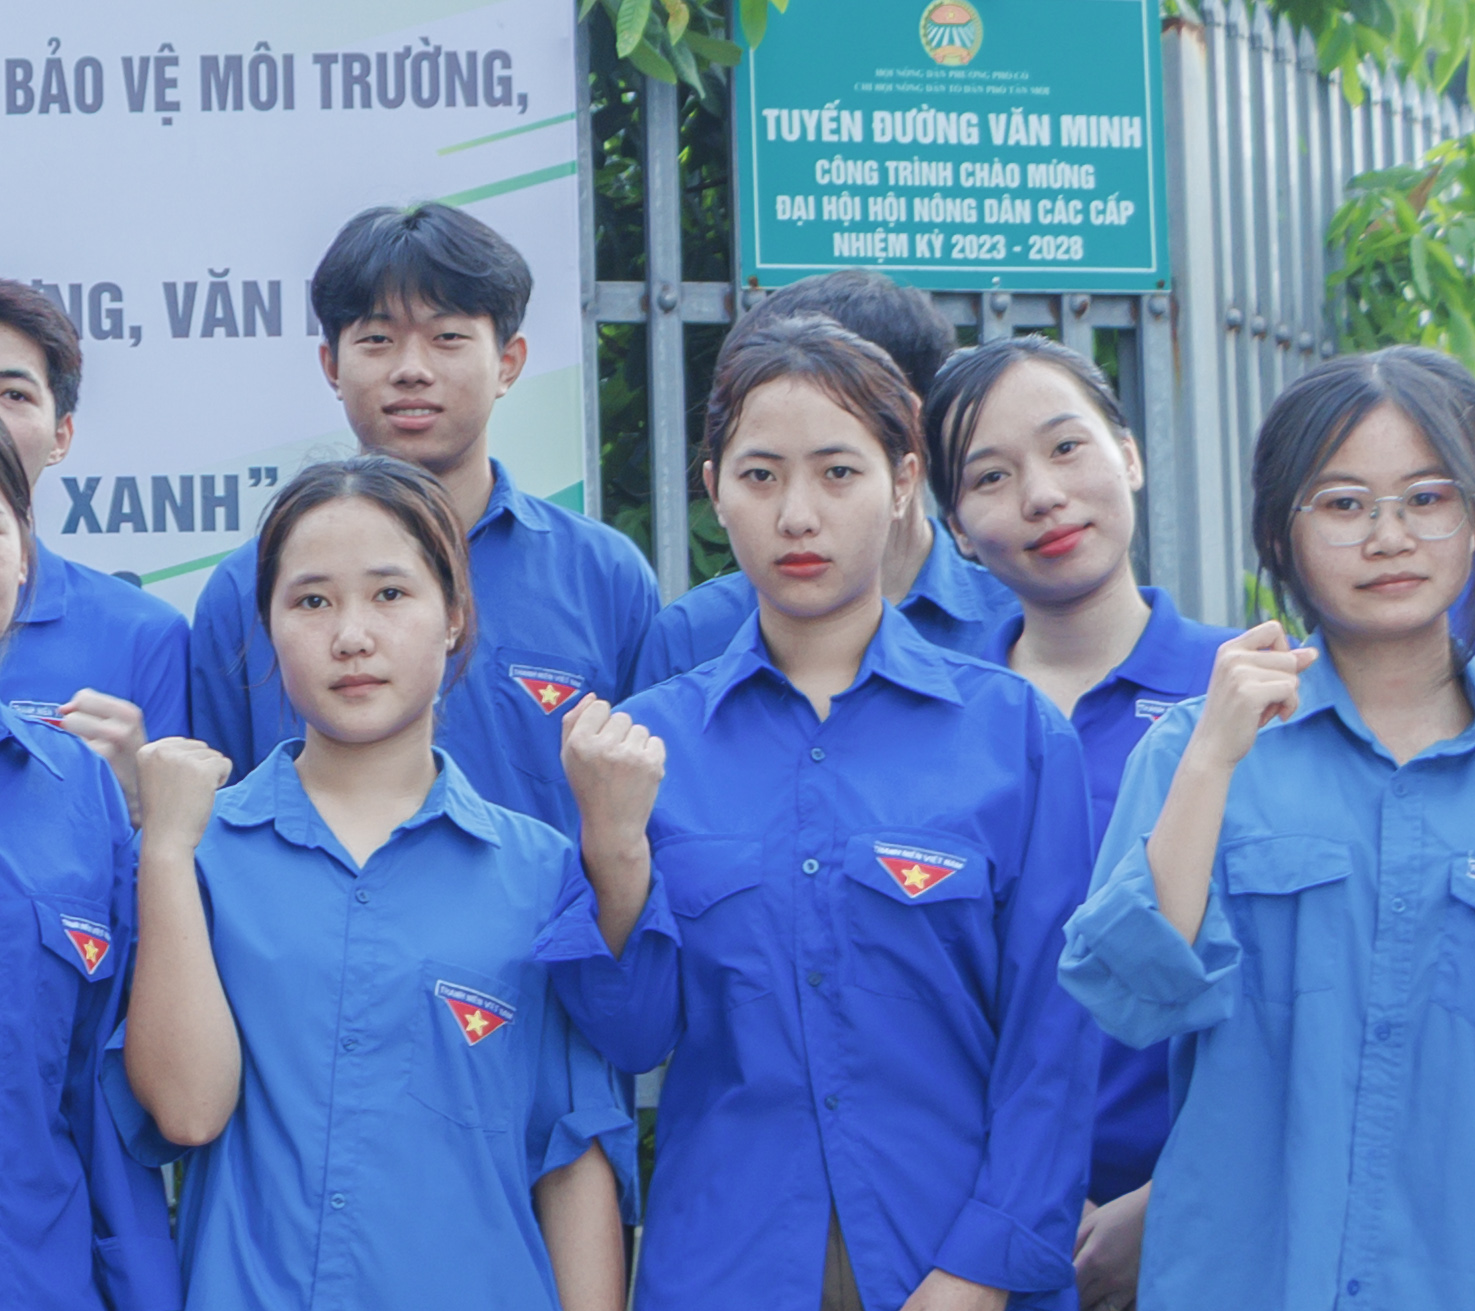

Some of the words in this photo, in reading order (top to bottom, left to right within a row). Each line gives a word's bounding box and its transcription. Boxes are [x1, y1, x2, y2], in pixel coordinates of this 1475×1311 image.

[4, 37, 104, 116] BẢO
[121, 43, 181, 126] VỆ
[200, 41, 295, 112] MÔI
[312, 37, 529, 114] TRƯỜNG,
[762, 99, 864, 143] TUYẾN
[872, 104, 980, 146] ĐƯỜNG
[988, 107, 1050, 147] VĂN
[1060, 115, 1143, 150] MINH
[815, 154, 879, 186] CÔNG
[886, 156, 954, 188] TRÌNH
[959, 157, 1020, 190] CHÀO
[775, 194, 816, 227] ĐẠI
[822, 191, 861, 228] HỘI
[868, 192, 907, 228] HỘI
[913, 193, 978, 225] NÔNG
[984, 194, 1032, 226] DÂN
[1037, 195, 1084, 227] CÁC
[1089, 191, 1135, 227] CẤP
[833, 227, 909, 265] NHIỆM
[951, 234, 1007, 260] 2023
[1028, 234, 1084, 261] 2028
[162, 267, 282, 338] VĂN
